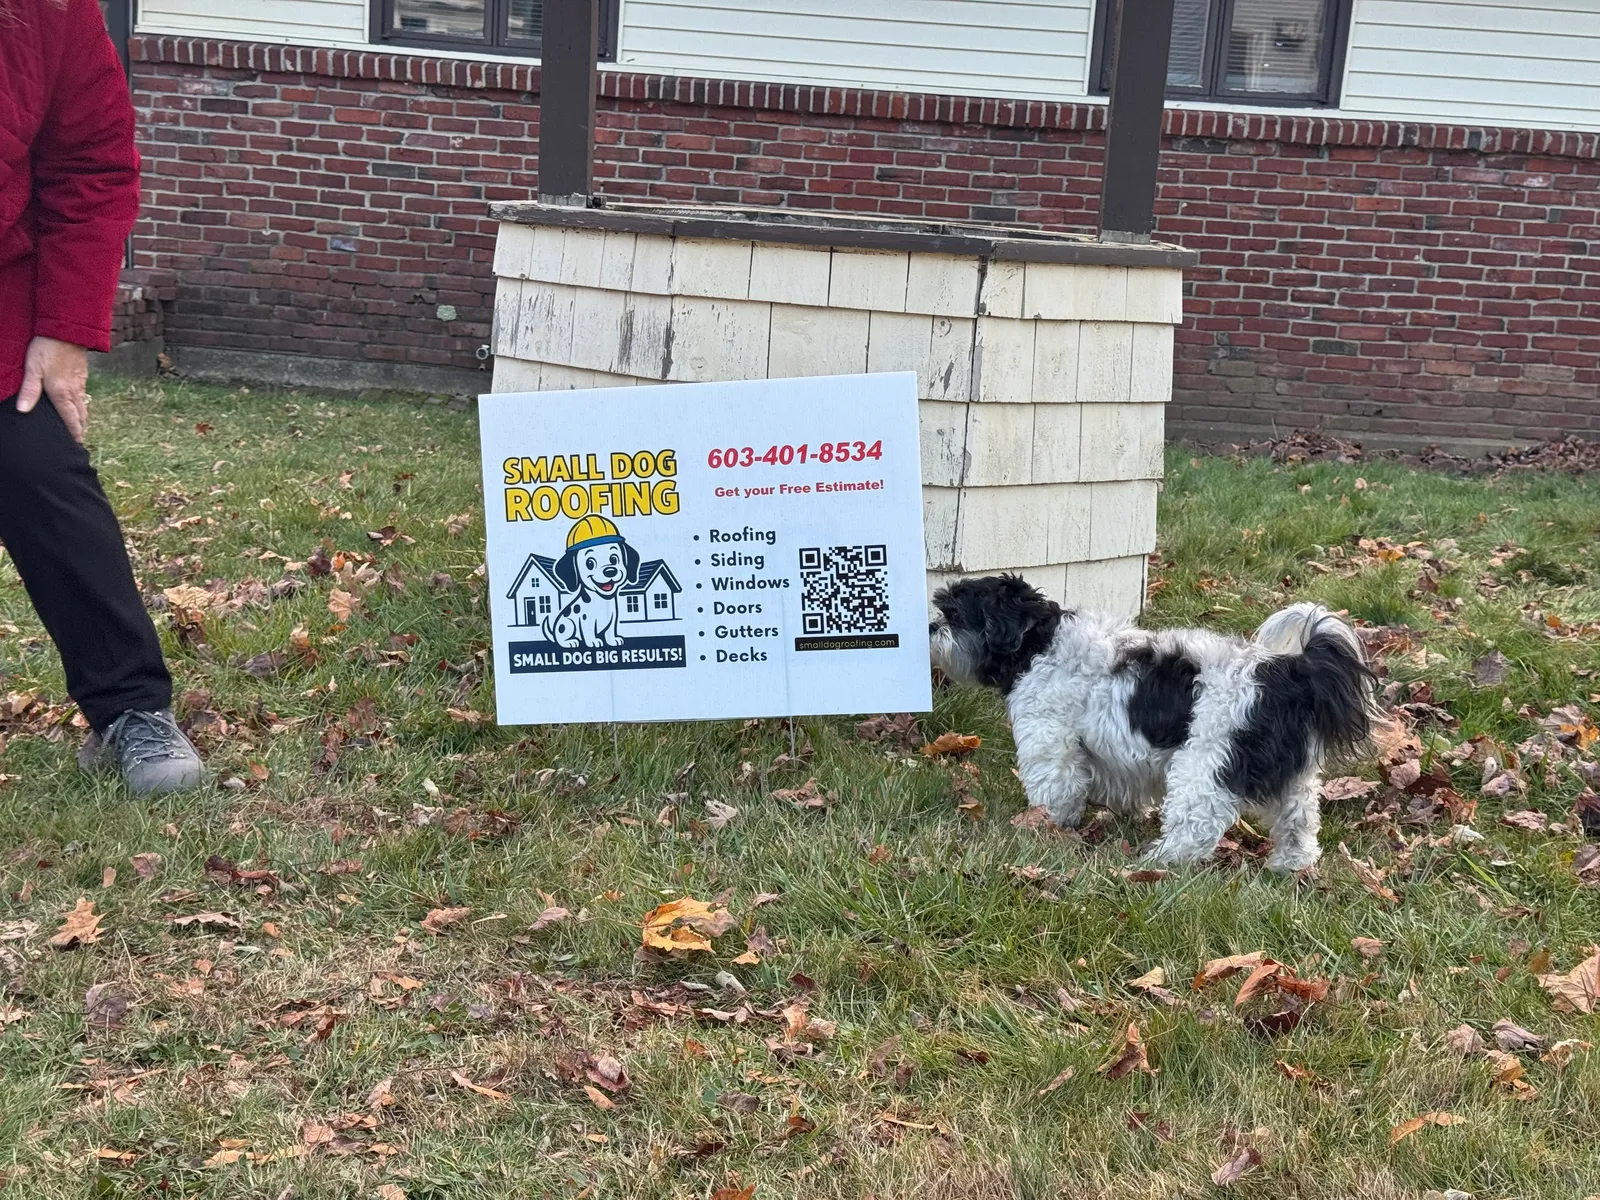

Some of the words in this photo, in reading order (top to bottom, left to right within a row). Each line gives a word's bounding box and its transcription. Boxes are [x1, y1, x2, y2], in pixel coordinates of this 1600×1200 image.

[708, 440, 883, 468] 603-401-8534
[503, 454, 604, 485] SMALL
[611, 450, 677, 479] DOG
[715, 486, 741, 497] Get
[744, 486, 775, 498] your
[779, 483, 812, 494] Free
[816, 480, 884, 493] Estimate!
[505, 480, 680, 522] ROOFING
[709, 527, 776, 545] Roofing
[711, 551, 765, 569] Siding
[711, 574, 790, 590] Windows
[714, 601, 762, 615] Doors
[715, 624, 778, 639] Gutters
[799, 638, 895, 650] smalldogroofing.com
[513, 652, 560, 667] SMALL
[562, 651, 592, 666] DOG
[596, 650, 619, 664] BIG
[622, 648, 683, 663] RESULTS!
[716, 646, 767, 663] Decks
